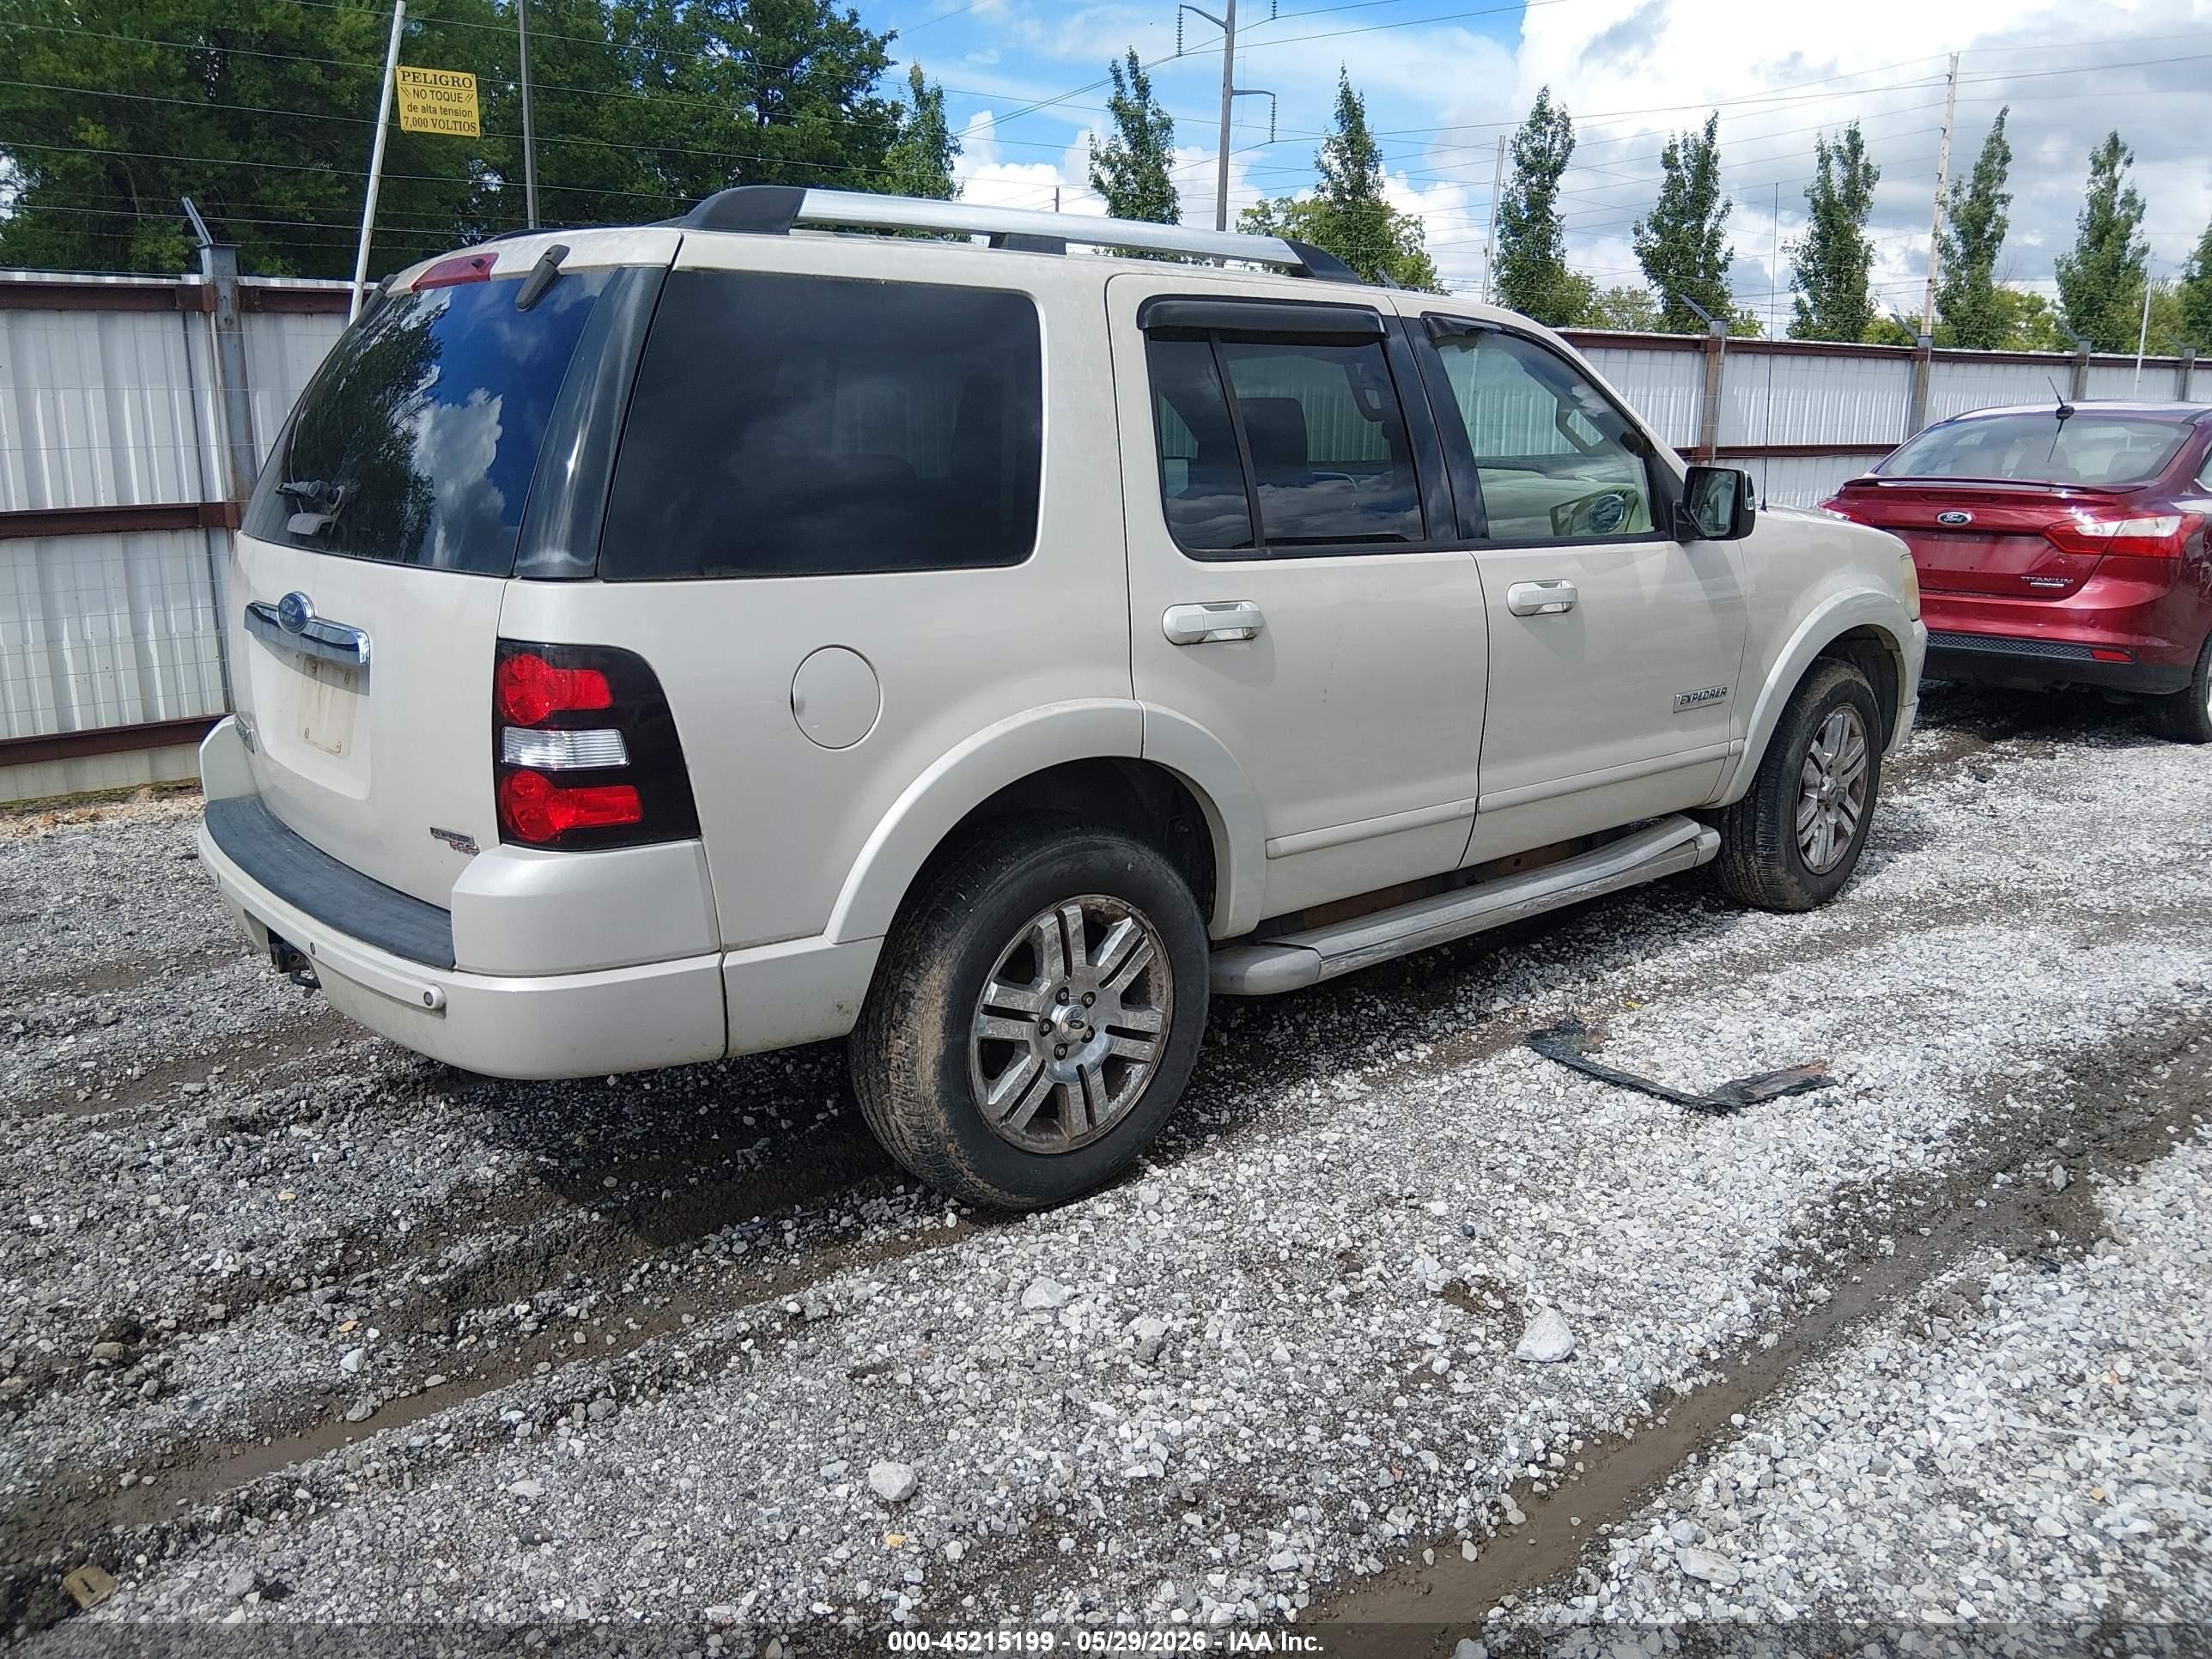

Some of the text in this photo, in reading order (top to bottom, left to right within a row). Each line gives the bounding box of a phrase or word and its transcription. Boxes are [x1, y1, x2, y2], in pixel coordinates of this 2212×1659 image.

[400, 70, 473, 89] PELIGRO
[413, 88, 464, 103] NO TOQUE
[407, 103, 473, 118] de alta tension
[404, 116, 477, 132] 7,000 VOLTIOS
[1677, 686, 1728, 705] EXPLORER
